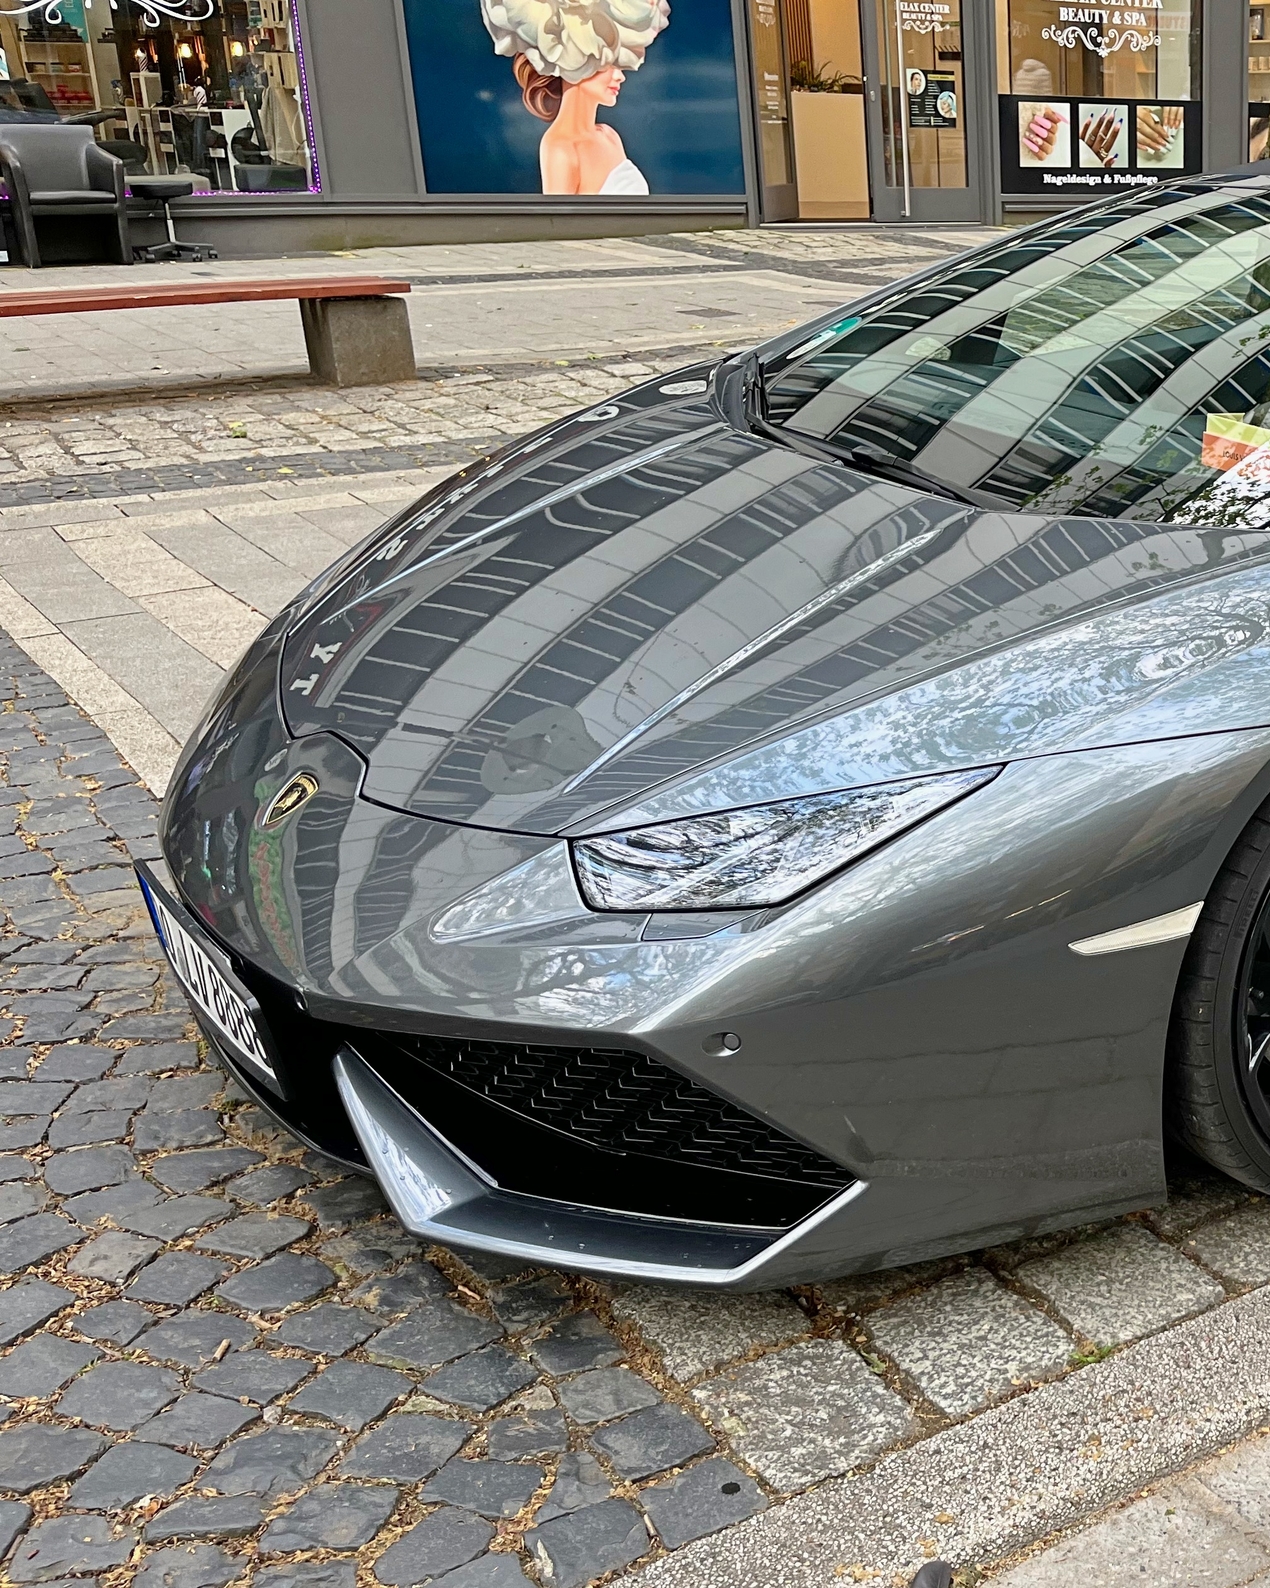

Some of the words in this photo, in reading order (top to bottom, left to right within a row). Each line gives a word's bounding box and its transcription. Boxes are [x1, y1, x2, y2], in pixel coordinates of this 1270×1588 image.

[899, 2, 920, 12] ELAX
[920, 3, 950, 14] CENTER
[1059, 6, 1110, 24] BEAUTY
[1112, 10, 1122, 25] &
[1123, 12, 1147, 26] SPA
[1043, 173, 1102, 186] Nageldesign
[1103, 174, 1112, 184] &
[1113, 174, 1159, 186] Fußpflege
